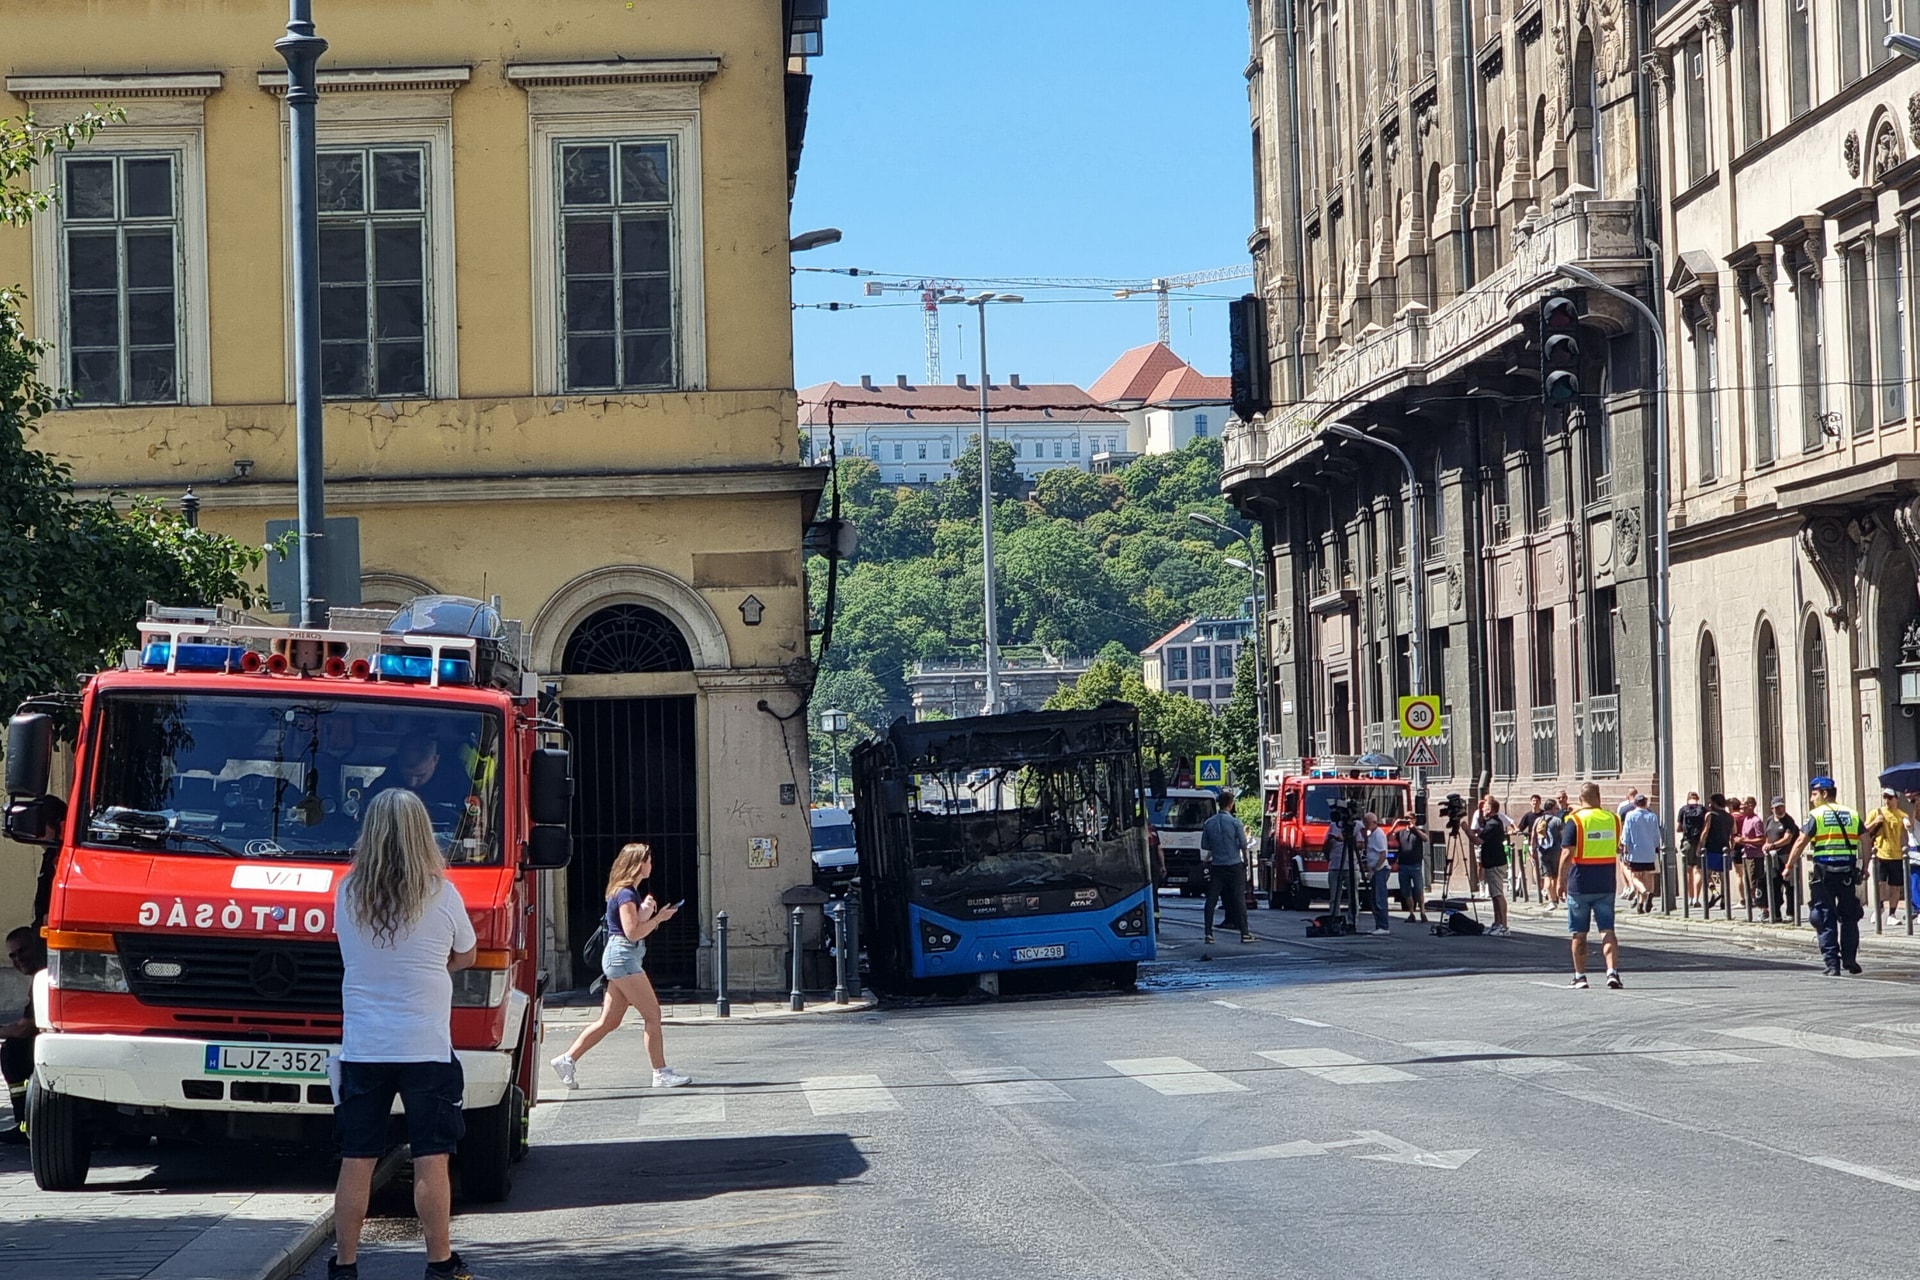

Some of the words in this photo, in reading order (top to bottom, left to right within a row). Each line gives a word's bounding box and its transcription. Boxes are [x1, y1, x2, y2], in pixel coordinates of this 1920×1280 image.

[1412, 710, 1427, 722] 30
[265, 870, 303, 886] V/1
[1070, 899, 1093, 907] ATAK
[1018, 946, 1062, 960] NCV-298
[223, 1048, 322, 1072] LJZ-352
